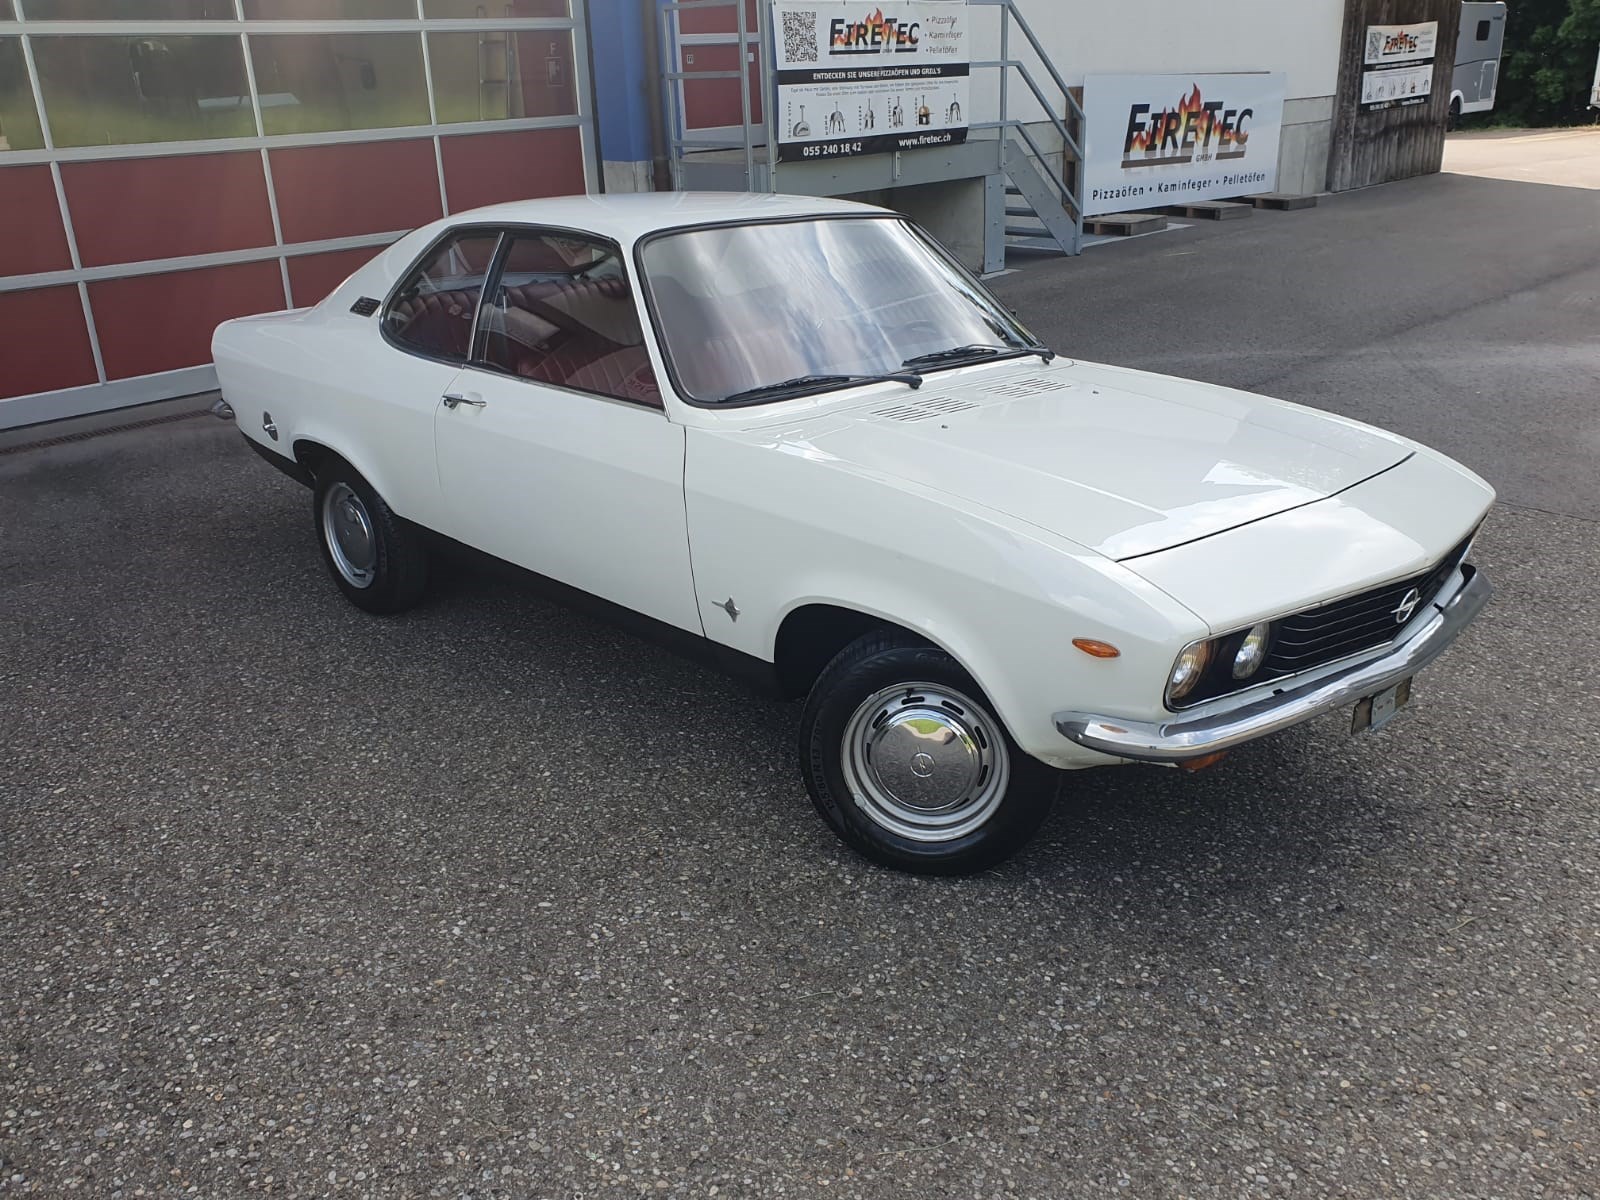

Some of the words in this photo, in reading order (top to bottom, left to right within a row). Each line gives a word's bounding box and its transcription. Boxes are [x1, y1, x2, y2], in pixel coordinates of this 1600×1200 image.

[829, 17, 920, 47] FIRETEC
[812, 72, 846, 80] ENTDECKEN
[847, 71, 857, 79] SIE
[910, 68, 921, 76] UND
[1123, 101, 1254, 152] FIRETEC
[898, 132, 951, 147] www.firetec.ch
[803, 146, 820, 156] 055
[822, 144, 838, 155] 240
[840, 143, 850, 153] 18
[851, 142, 862, 152] 42
[1195, 153, 1213, 163] GMBH
[1092, 185, 1144, 201] Pizzaöfen
[1157, 179, 1212, 193] Kaminfeger
[1223, 172, 1266, 186] Pelletöfen
